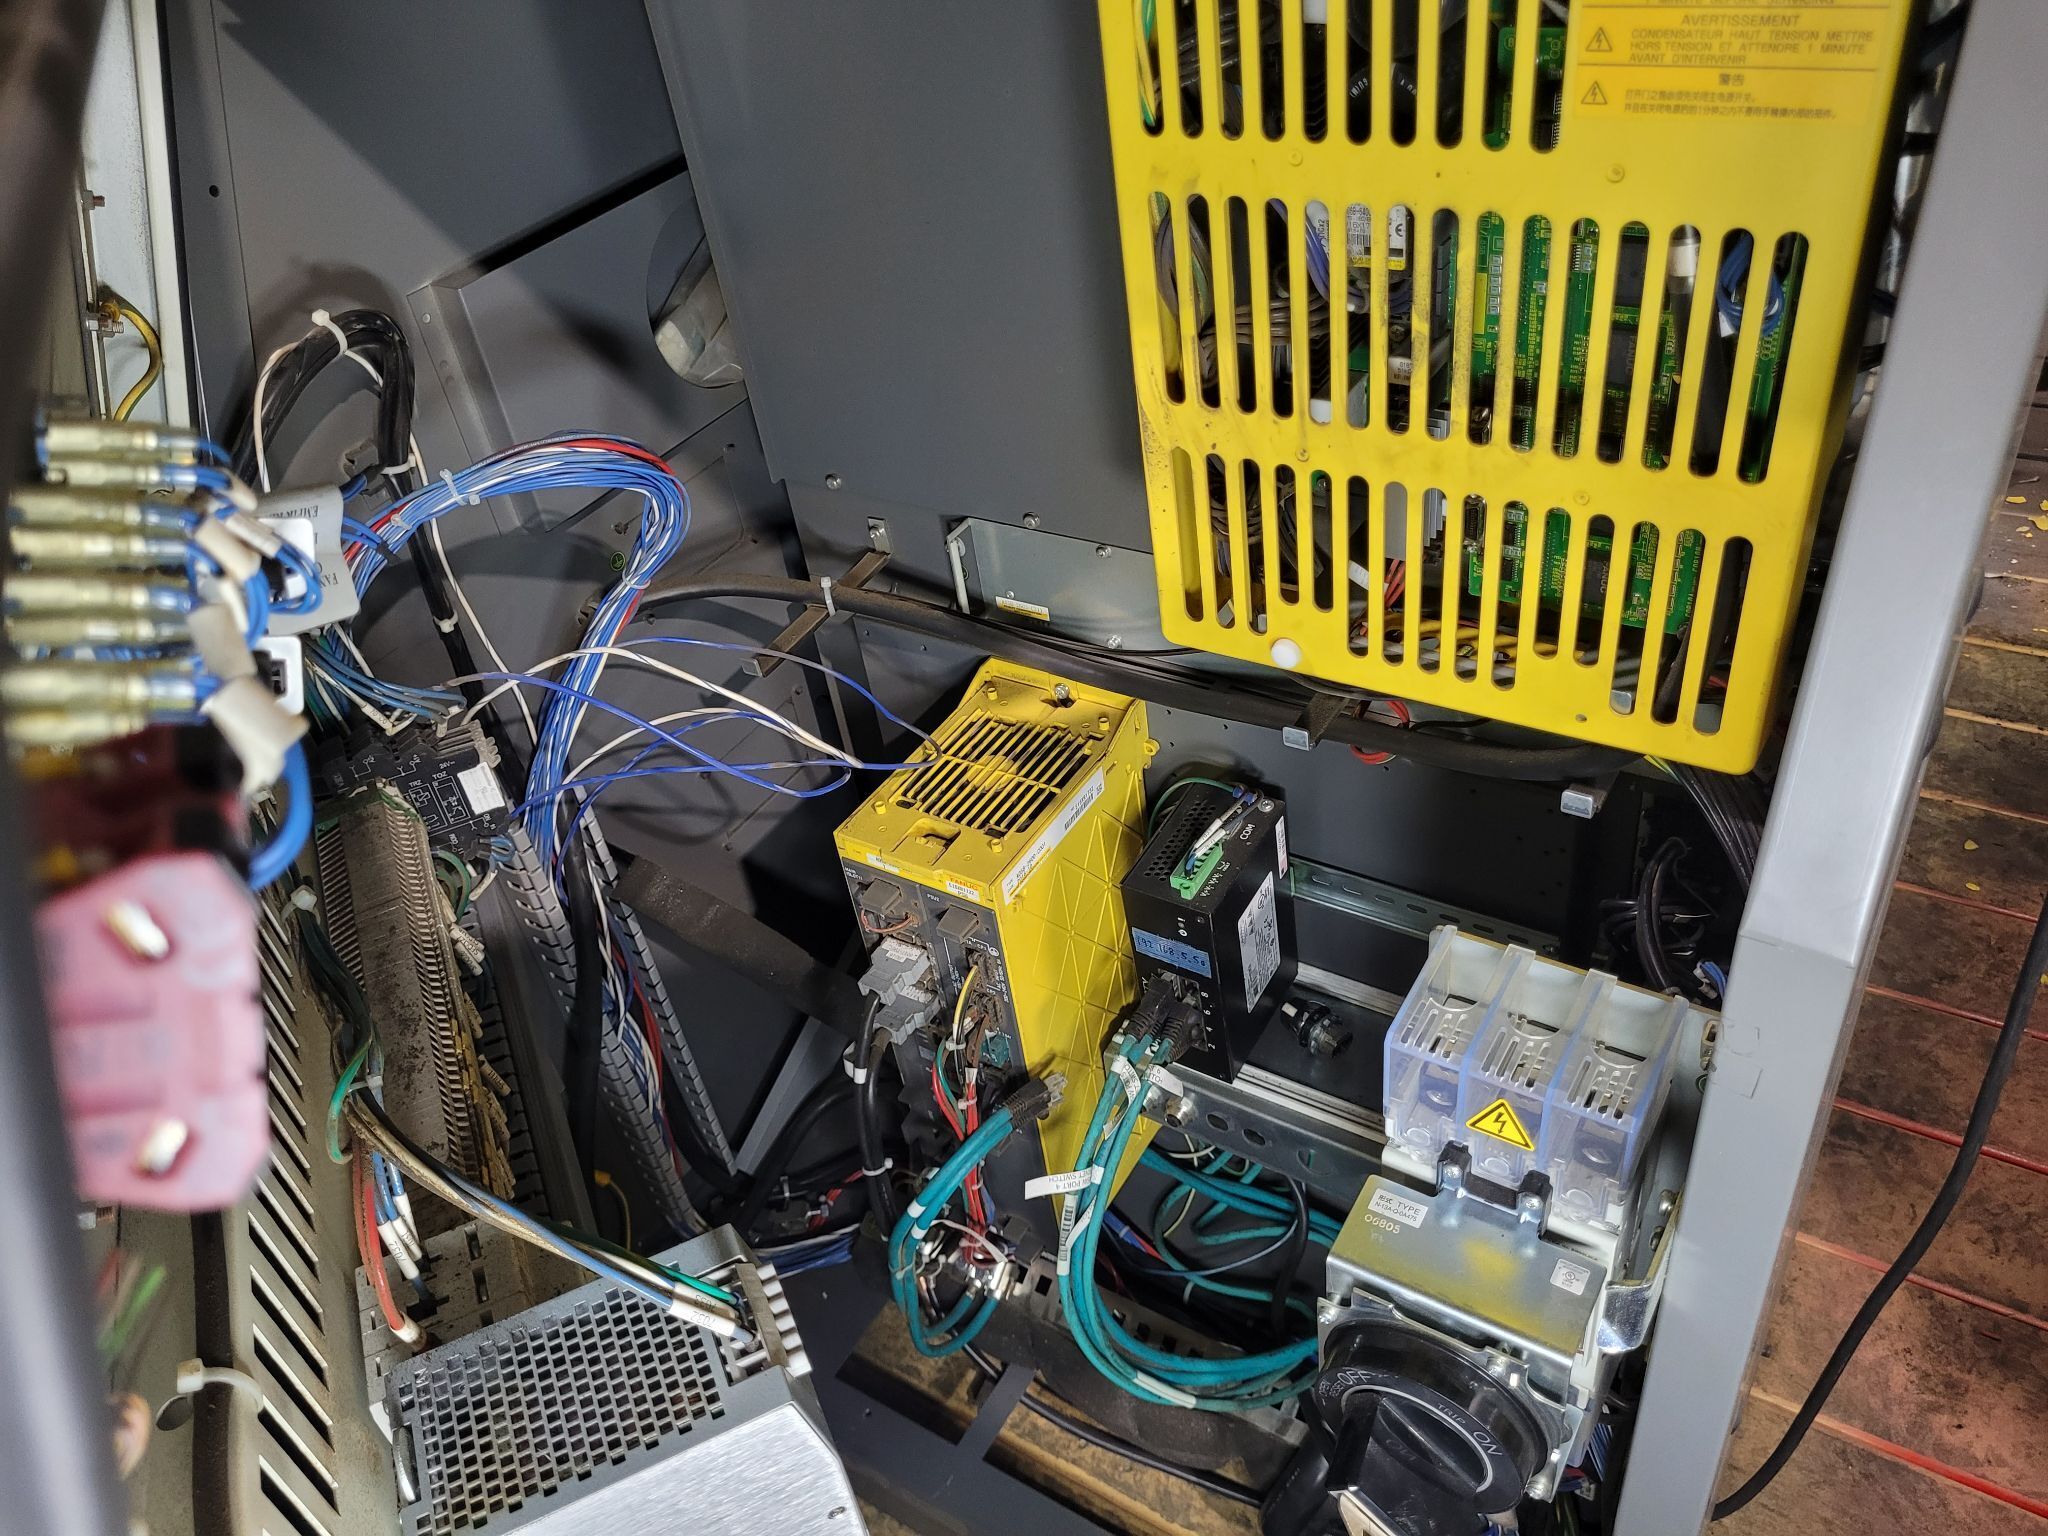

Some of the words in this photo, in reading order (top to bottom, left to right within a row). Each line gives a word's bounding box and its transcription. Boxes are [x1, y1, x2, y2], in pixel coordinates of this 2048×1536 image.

[1681, 14, 1800, 27] AVERTISSEMENT
[1631, 28, 1724, 40] CONDENSATEUR
[1729, 30, 1762, 41] HAUT
[1769, 30, 1819, 42] TENSION
[1825, 31, 1874, 42] METTRE
[1630, 41, 1661, 51] HORS
[1664, 41, 1713, 52] TENSION
[1718, 42, 1731, 53] ET
[1739, 43, 1800, 54] ATTENDRE
[1819, 44, 1866, 55] MINUTE
[1629, 53, 1666, 63] AVANT
[1672, 54, 1747, 65] D'INTERVENIR
[1719, 73, 1745, 86] 警告
[1600, 558, 1610, 594] ANUC
[1240, 822, 1256, 841] COM
[1048, 1173, 1077, 1184] SWITCH
[1063, 1180, 1081, 1190] PORT
[1397, 1201, 1421, 1216] TYPE
[1337, 1370, 1372, 1386] OFF
[1436, 1402, 1467, 1425] TRIP
[1472, 1431, 1503, 1456] ON
